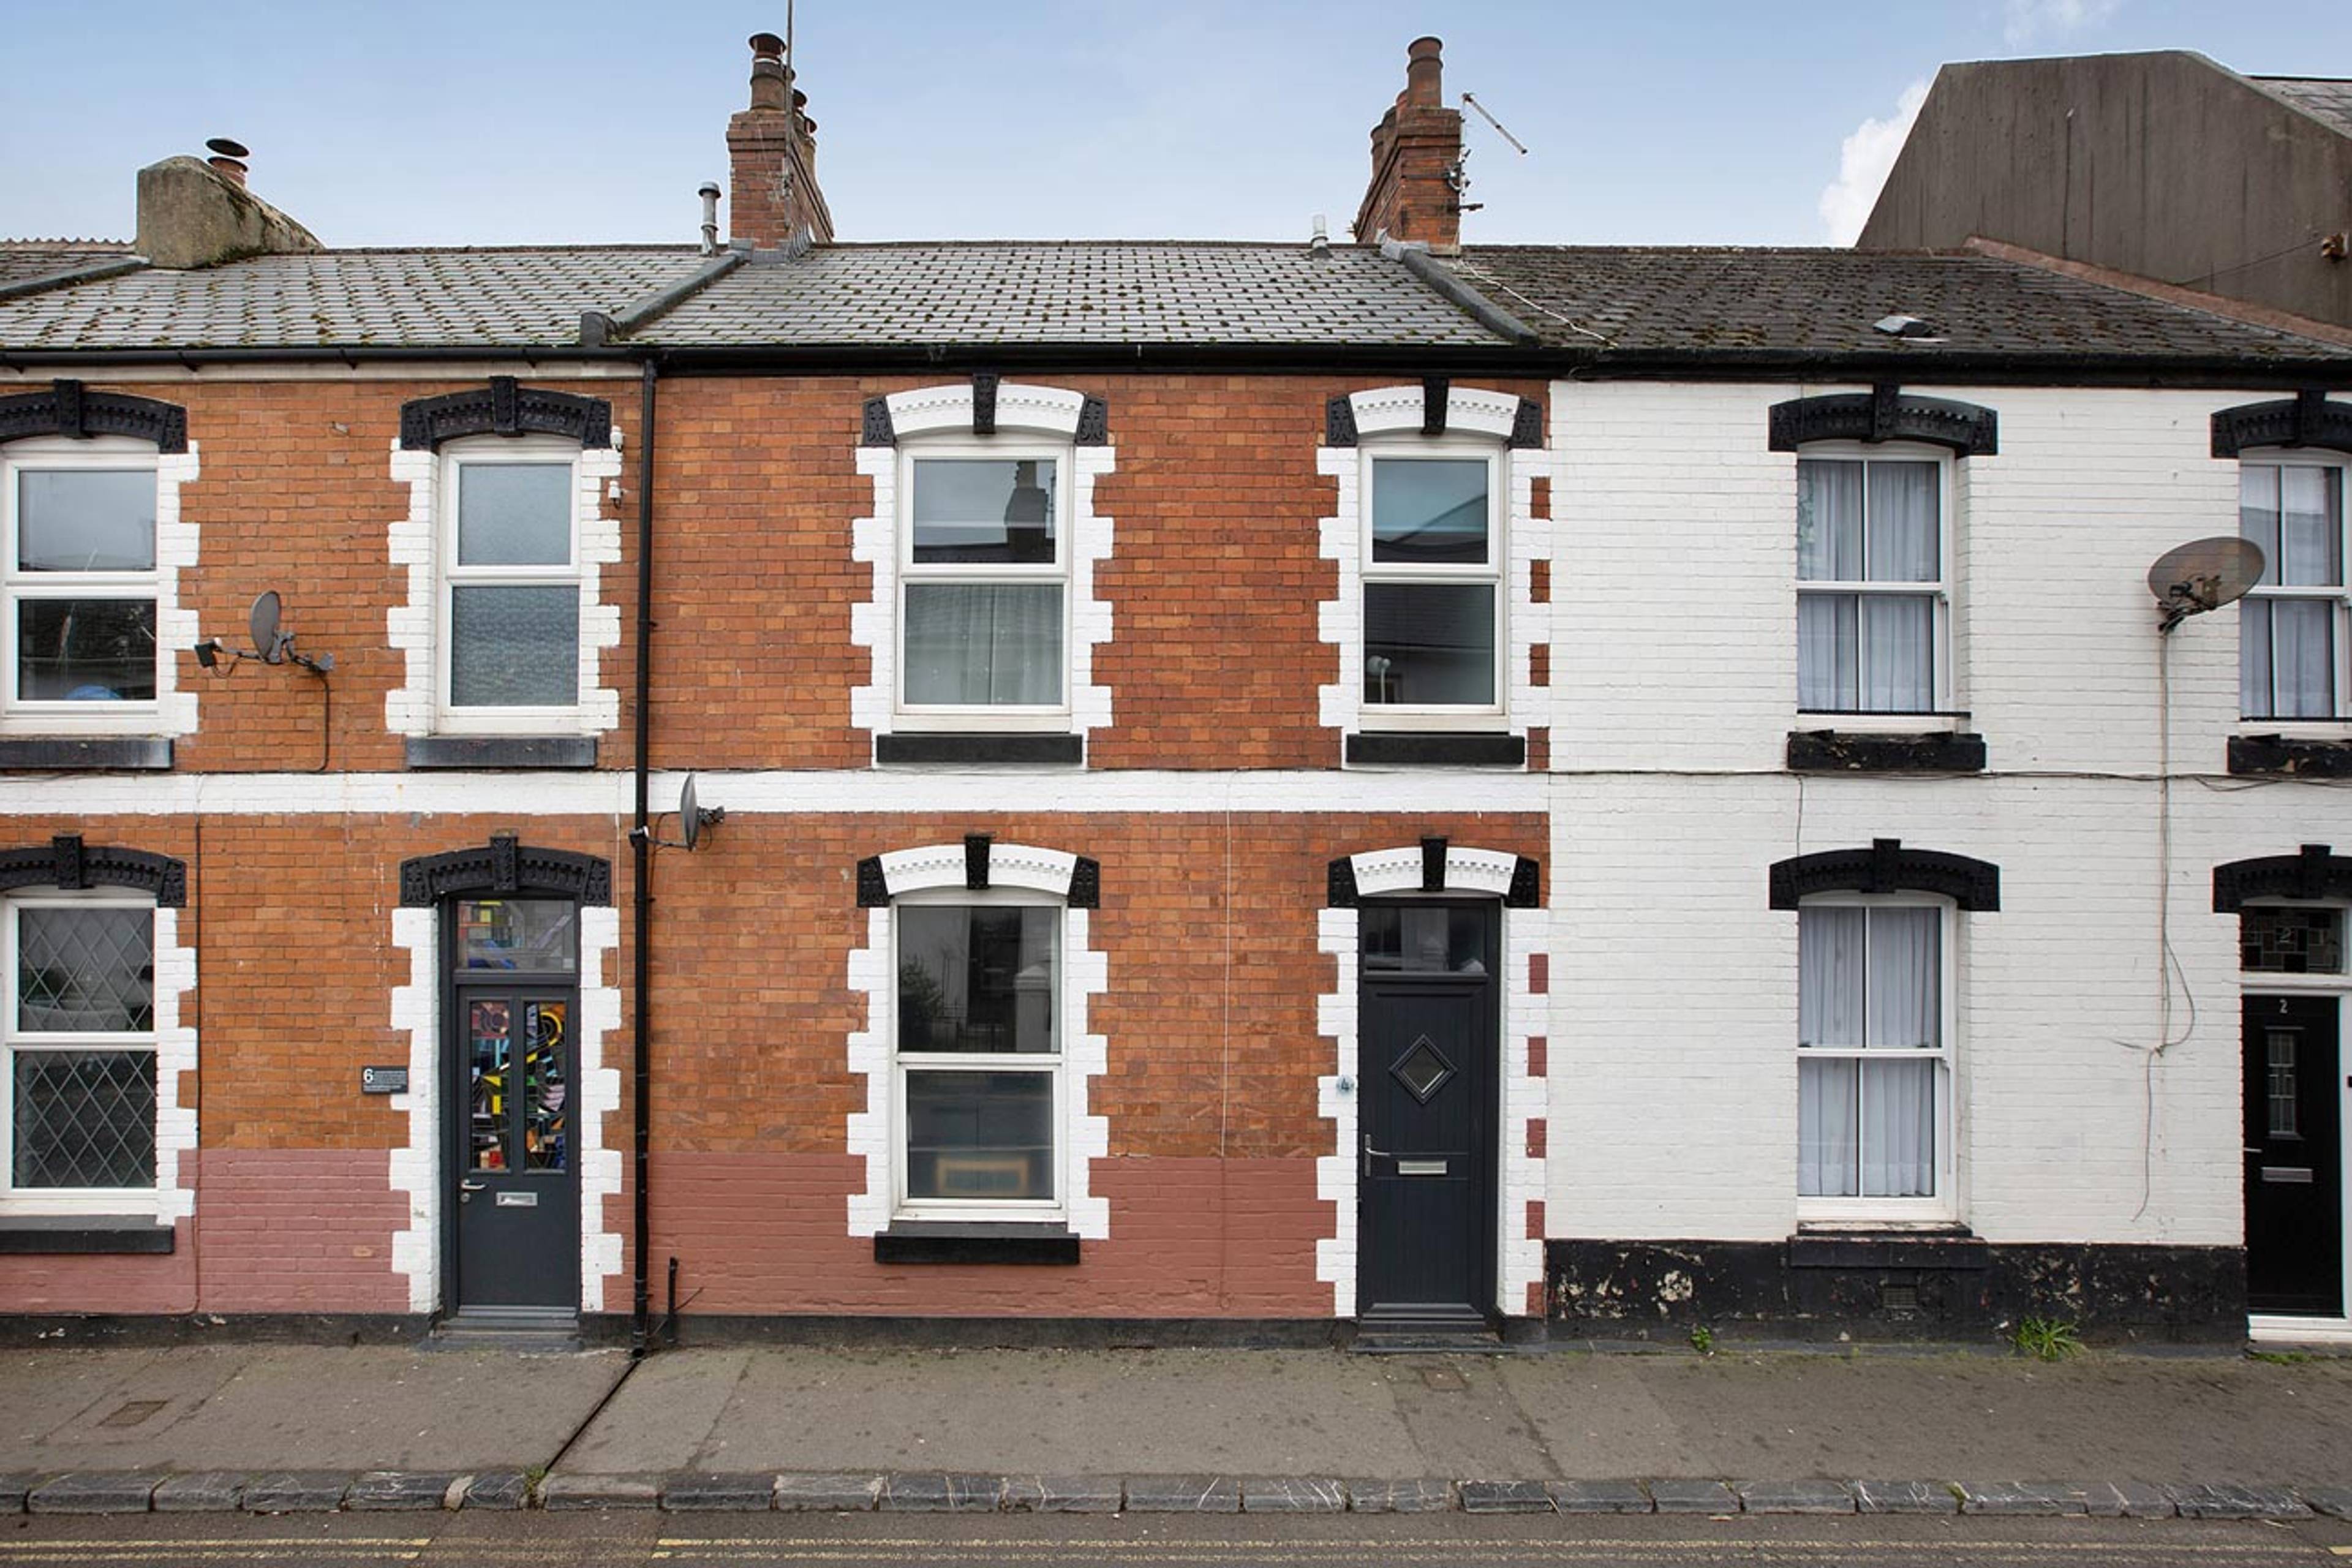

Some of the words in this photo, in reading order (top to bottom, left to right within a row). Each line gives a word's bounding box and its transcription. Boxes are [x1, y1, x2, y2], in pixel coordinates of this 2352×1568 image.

[2279, 927, 2291, 943] 2
[2279, 998, 2288, 1014] 2
[363, 1068, 374, 1083] 6
[1341, 1077, 1349, 1092] 4
